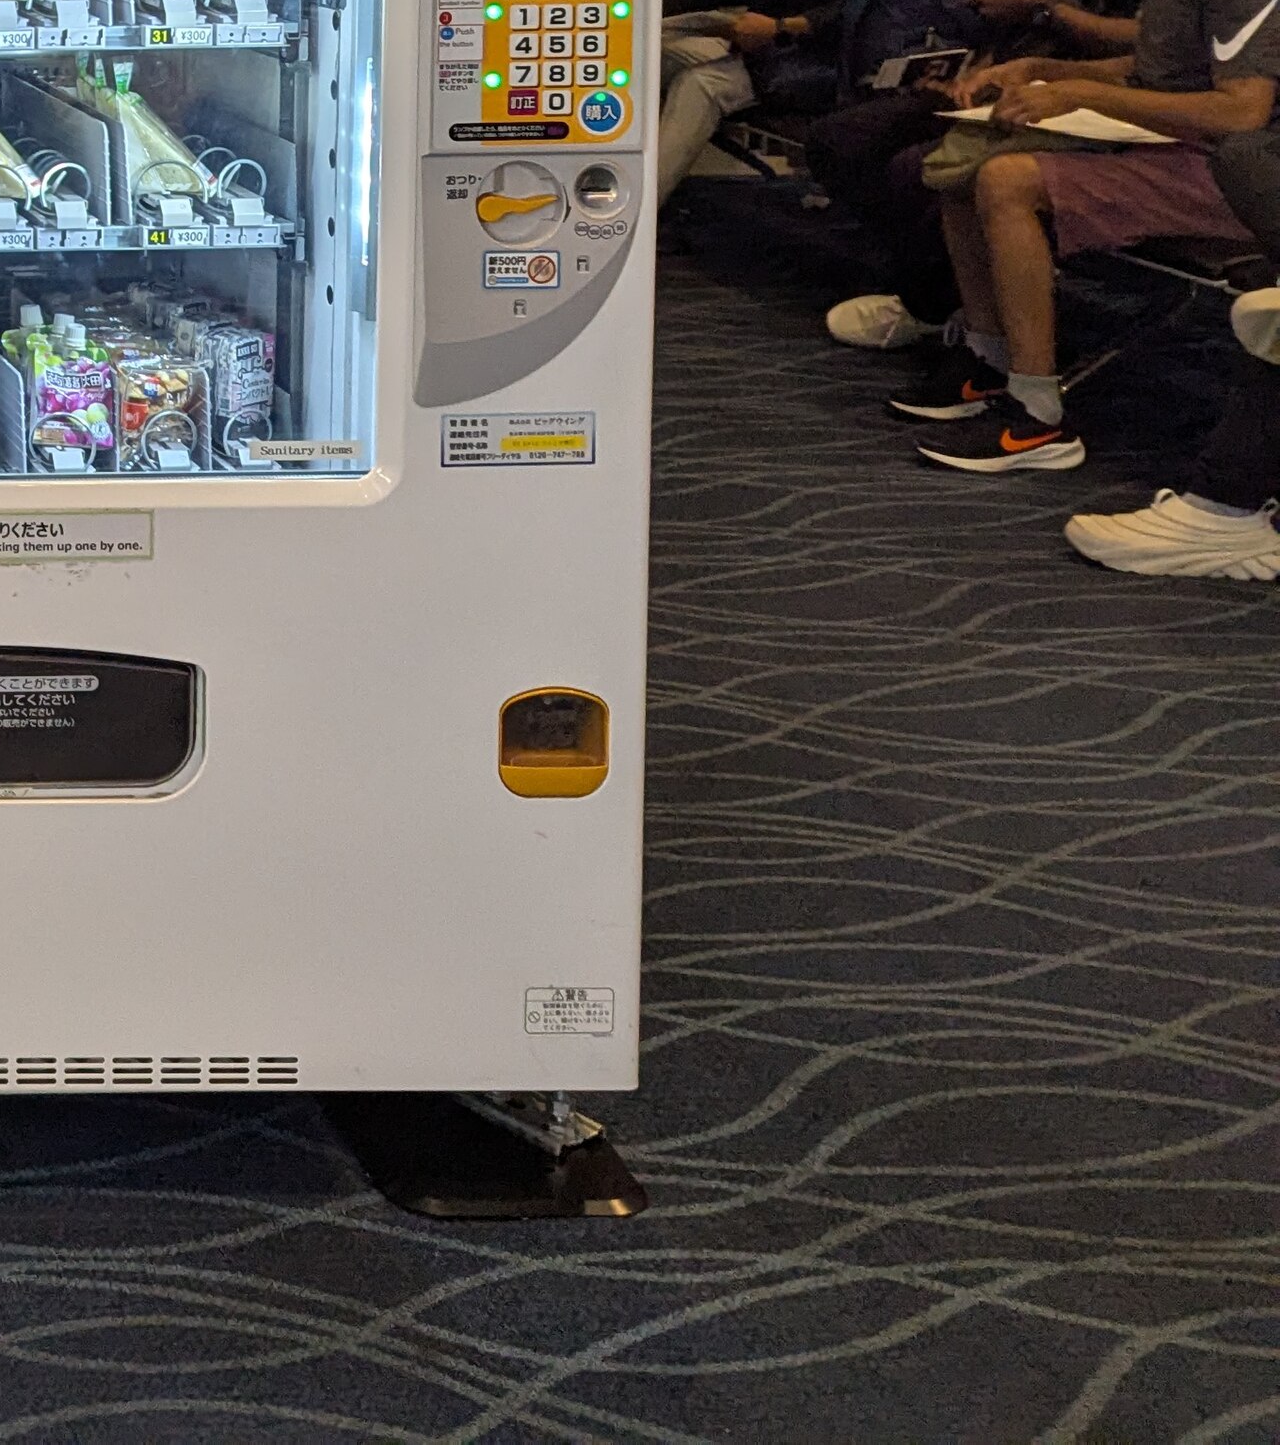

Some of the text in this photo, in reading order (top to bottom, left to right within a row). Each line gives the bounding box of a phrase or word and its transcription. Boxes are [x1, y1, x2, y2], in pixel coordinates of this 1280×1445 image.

[152, 30, 205, 43] 31 ¥300
[446, 188, 468, 200] 返却
[260, 443, 353, 458] Sanitary items
[24, 542, 53, 552] them
[57, 544, 72, 554] up
[75, 543, 97, 551] one
[100, 541, 114, 553] by
[118, 542, 143, 551] one.
